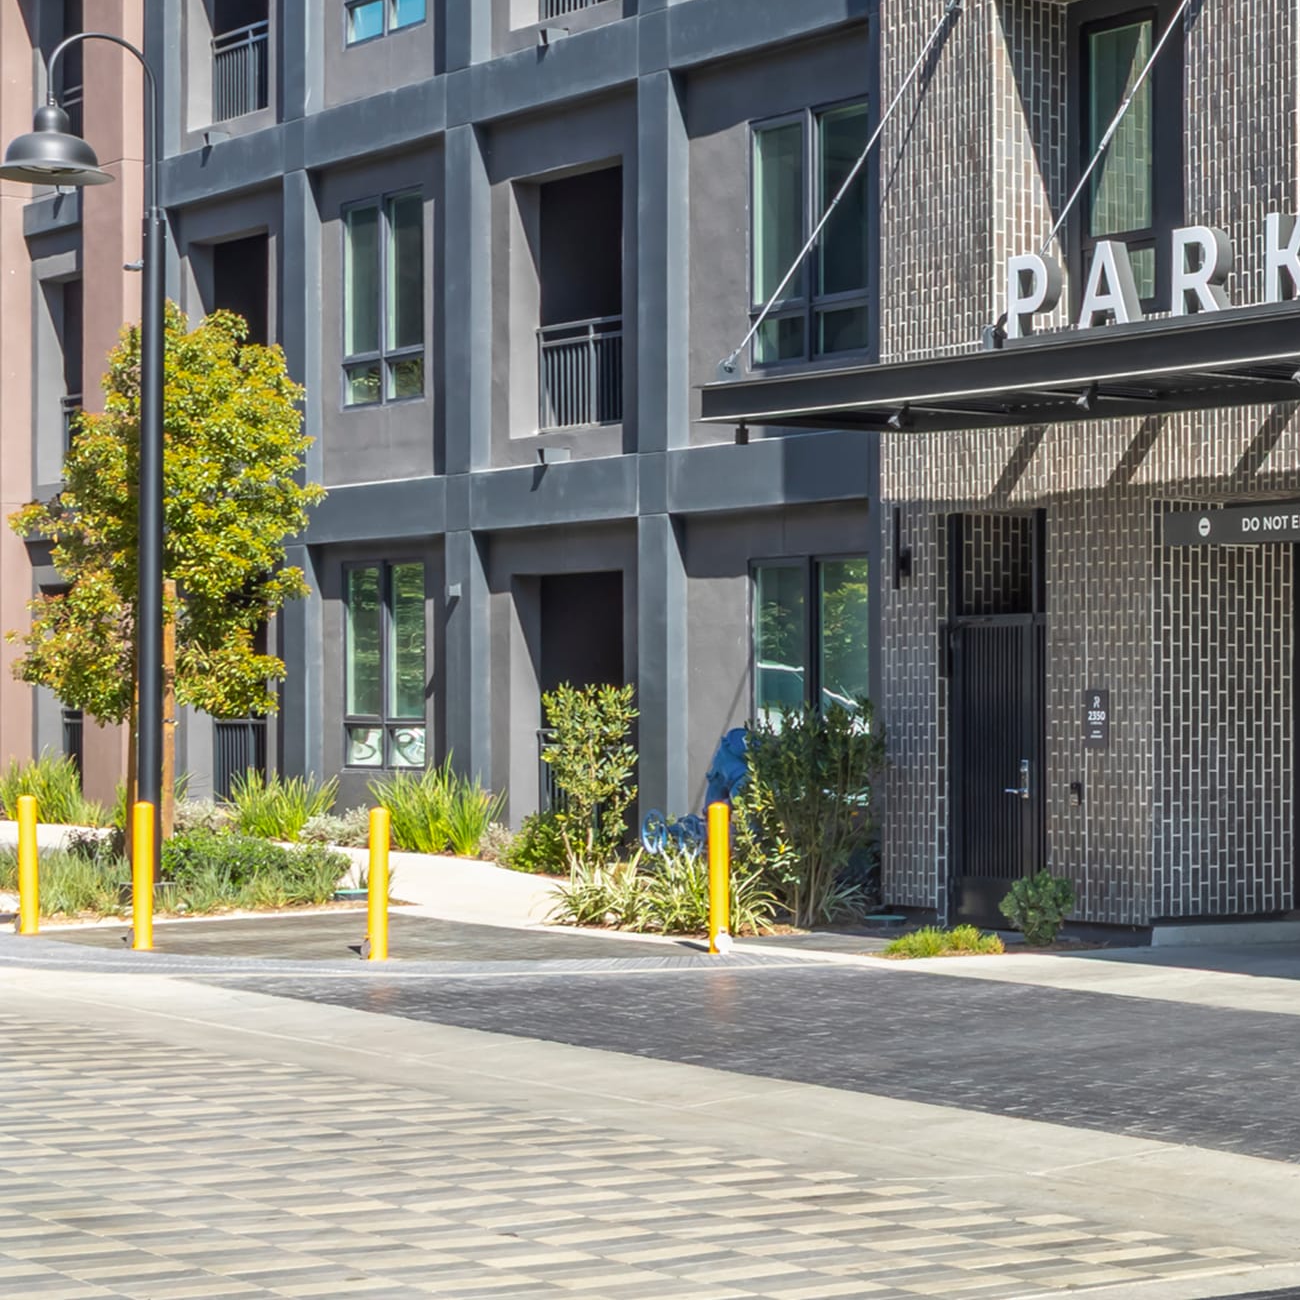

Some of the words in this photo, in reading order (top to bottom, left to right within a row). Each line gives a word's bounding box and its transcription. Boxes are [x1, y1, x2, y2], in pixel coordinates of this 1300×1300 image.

[1241, 515, 1261, 532] DO
[1263, 515, 1289, 531] NOT
[1087, 710, 1106, 721] 2350
